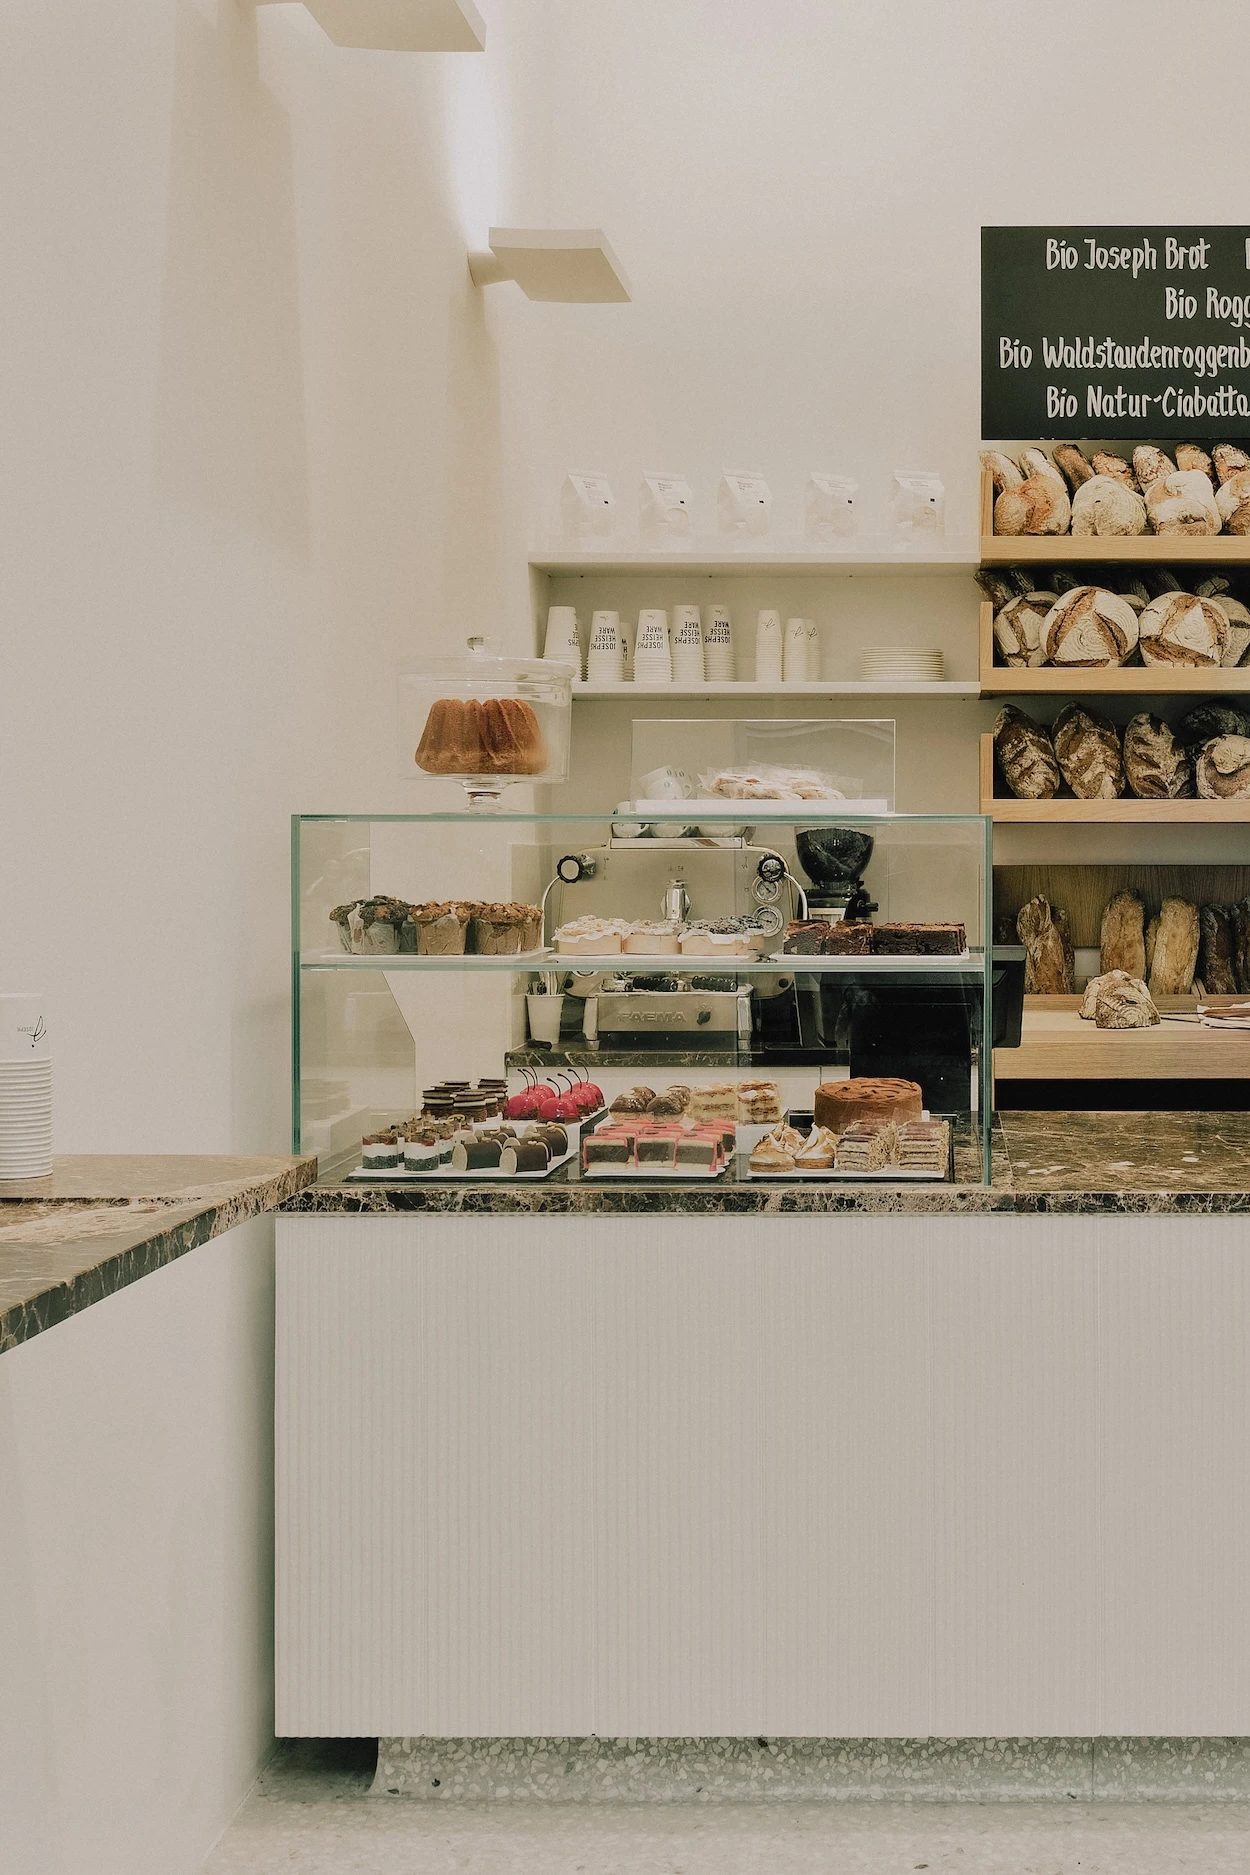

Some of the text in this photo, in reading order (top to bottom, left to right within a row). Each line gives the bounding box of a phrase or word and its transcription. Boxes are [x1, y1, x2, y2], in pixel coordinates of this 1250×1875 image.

[1047, 237, 1211, 278] Bio Joseph Brot
[1165, 287, 1198, 320] Bio
[1000, 337, 1033, 369] Bio
[1047, 386, 1078, 418] Bio
[684, 621, 699, 629] WARE
[714, 620, 730, 628] WARE
[680, 629, 700, 637] HEISSE
[709, 628, 731, 636] HEISSE
[617, 1011, 687, 1022] FAEMA
